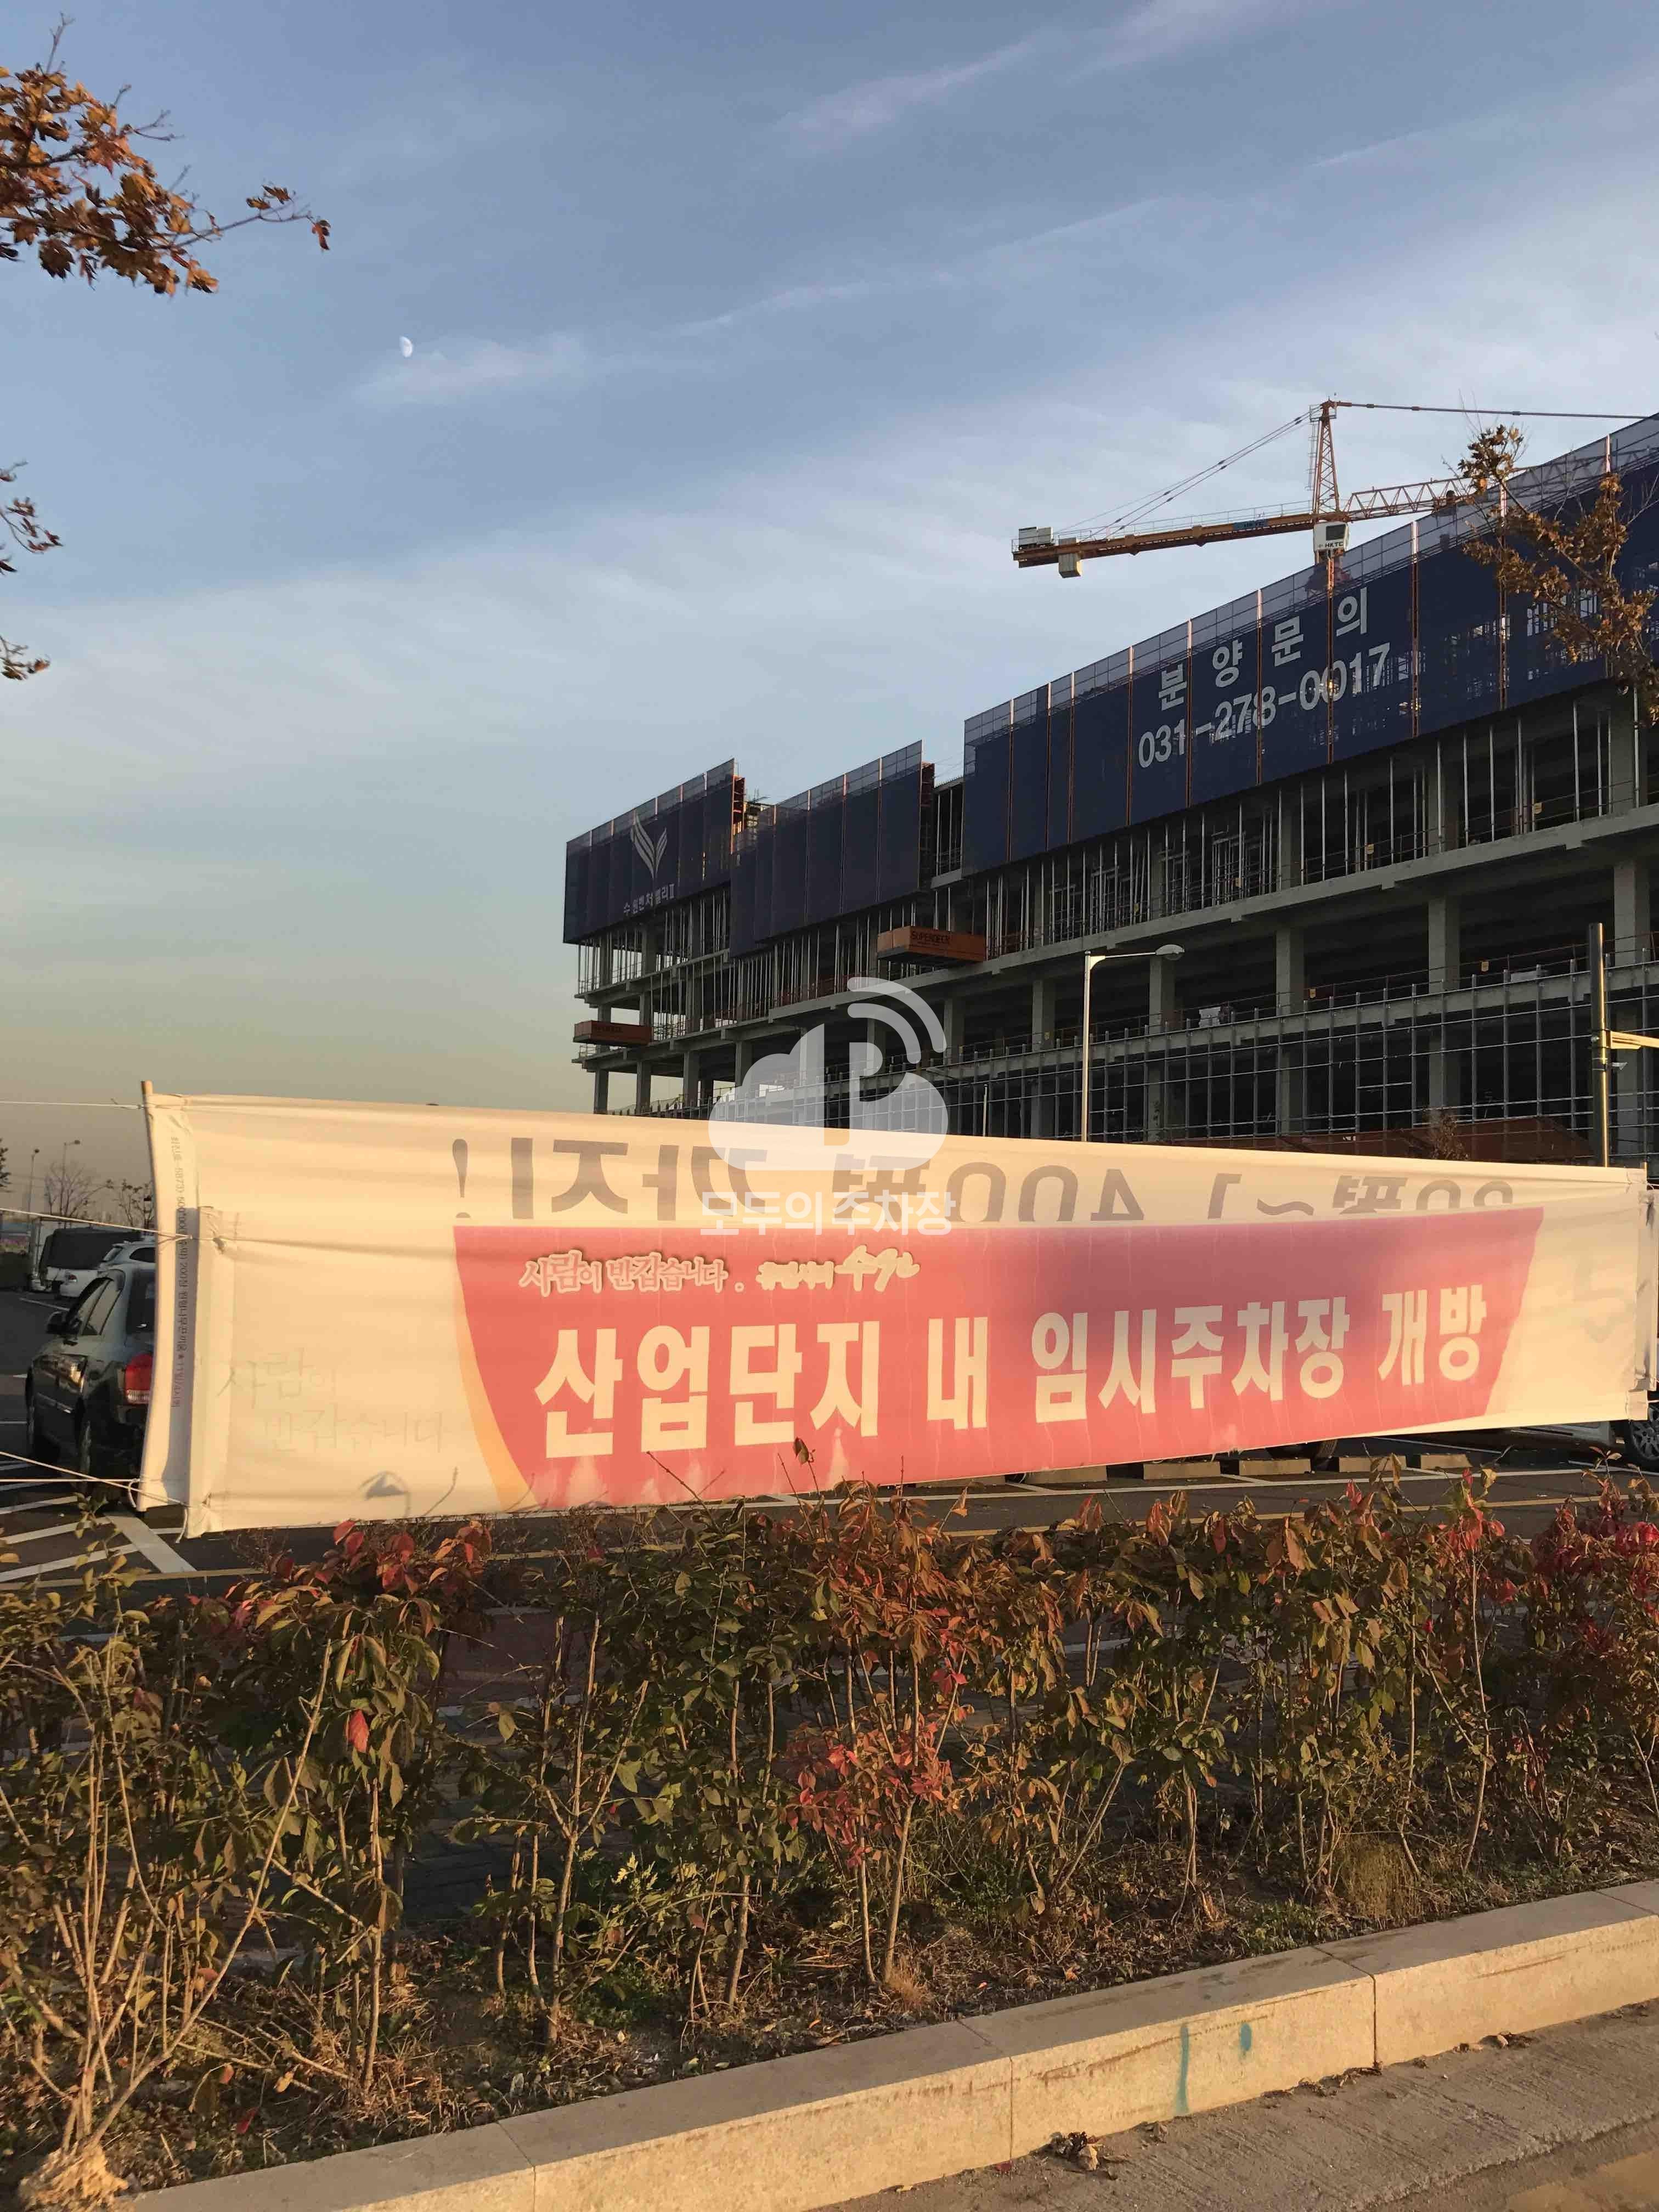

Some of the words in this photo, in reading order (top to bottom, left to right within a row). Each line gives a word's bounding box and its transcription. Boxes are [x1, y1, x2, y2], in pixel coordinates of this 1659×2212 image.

[1138, 642, 1391, 769] 031-278-0017
[518, 1249, 603, 1297] 사람이
[534, 1321, 880, 1459] 산업단지
[926, 1317, 988, 1430] 내
[1031, 1296, 1350, 1424] 임시주차장
[1378, 1284, 1486, 1387] 개방
